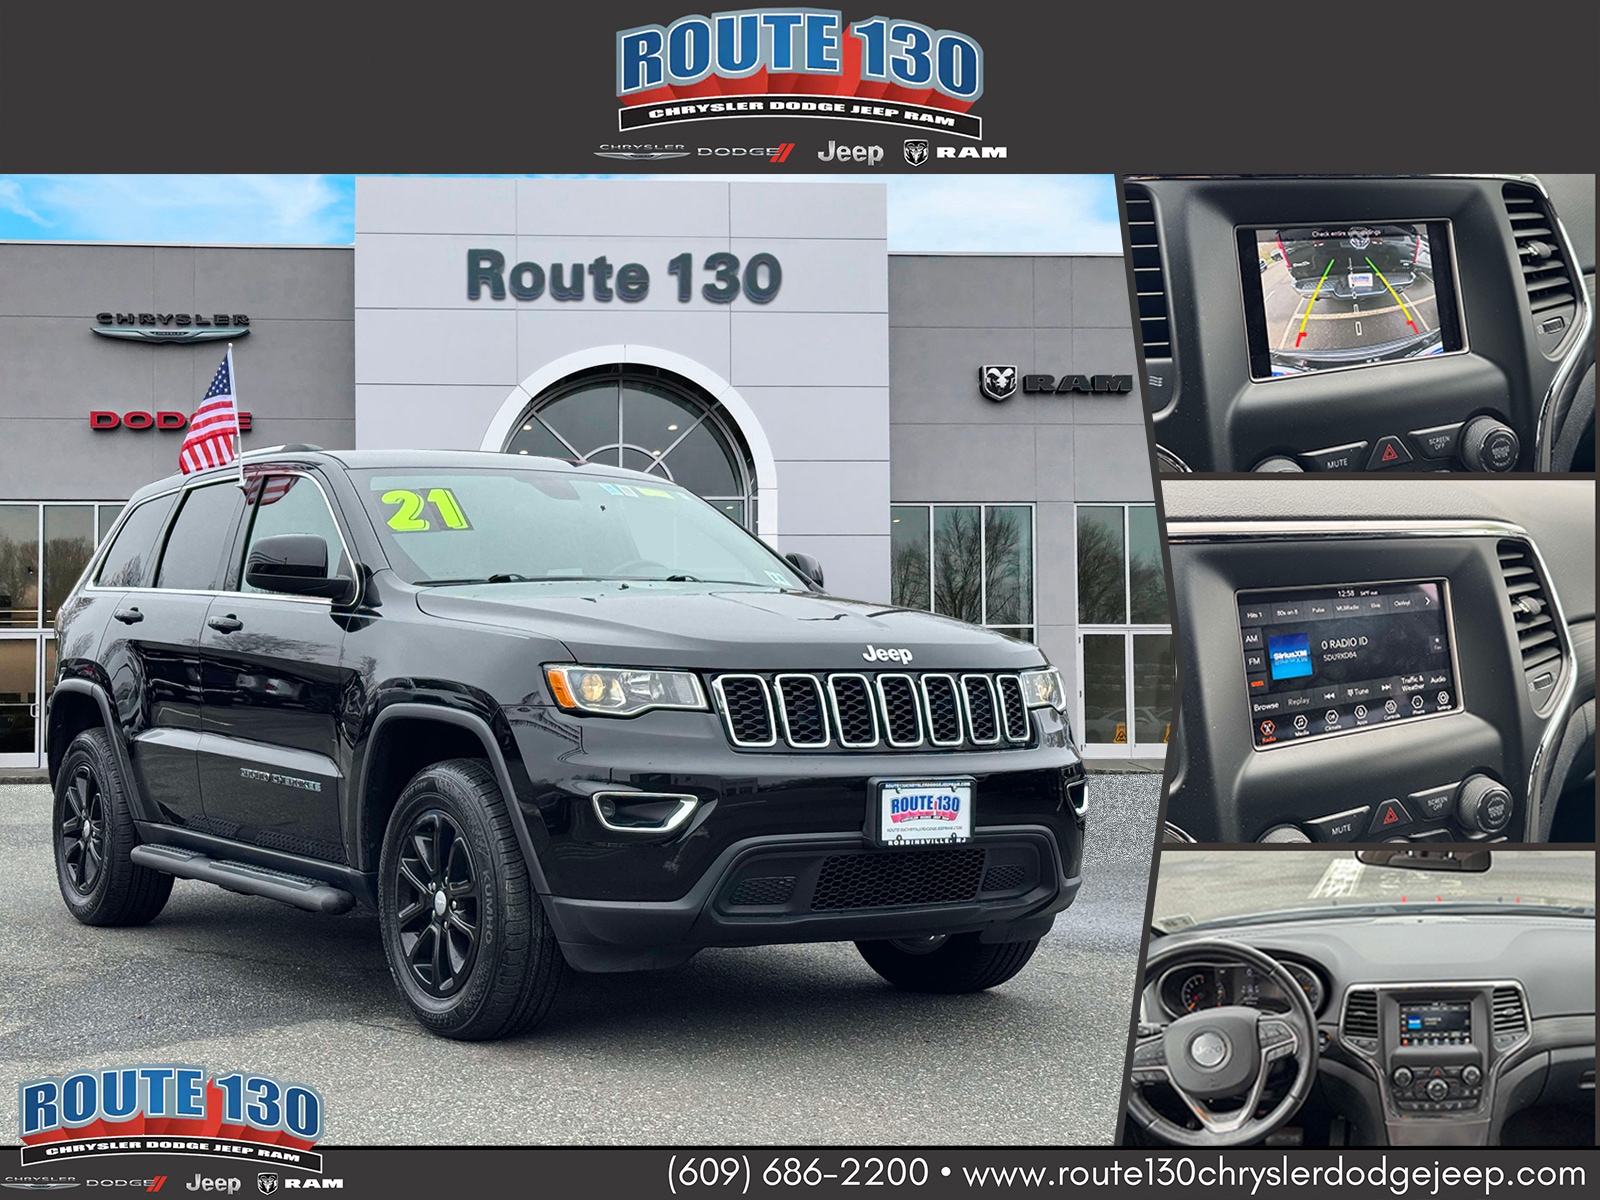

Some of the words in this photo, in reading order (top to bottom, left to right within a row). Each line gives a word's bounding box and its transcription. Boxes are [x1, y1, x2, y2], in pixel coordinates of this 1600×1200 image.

[1311, 230, 1330, 238] Check
[466, 248, 651, 302] Route
[667, 251, 783, 304] 130
[95, 312, 250, 326] CHRYSLER
[1022, 374, 1133, 395] RAM
[89, 410, 252, 432] DODE
[1428, 435, 1451, 446] SCREEN
[1434, 442, 1446, 450] OFF
[1326, 457, 1348, 470] MUTE
[380, 488, 471, 532] 21
[1337, 589, 1355, 598] 12:58
[1245, 634, 1259, 643] AM
[1329, 636, 1357, 649] RADIO
[1358, 635, 1369, 646] ID
[862, 644, 914, 665] Jeep
[1273, 649, 1308, 660] SiriusXM
[1248, 656, 1261, 666] FM
[1401, 676, 1418, 684] Traffic
[1430, 675, 1447, 684] Audio
[1354, 687, 1370, 696] Tune
[1401, 683, 1425, 693] Weather
[1287, 696, 1310, 706] Replay
[1253, 702, 1280, 712] Browse
[891, 795, 934, 814] ROUTE
[935, 795, 961, 812] 130
[1427, 796, 1449, 807] SCREEN
[1432, 802, 1444, 811] OFF
[1331, 823, 1352, 836] MUTE
[482, 869, 493, 945] KUMHO
